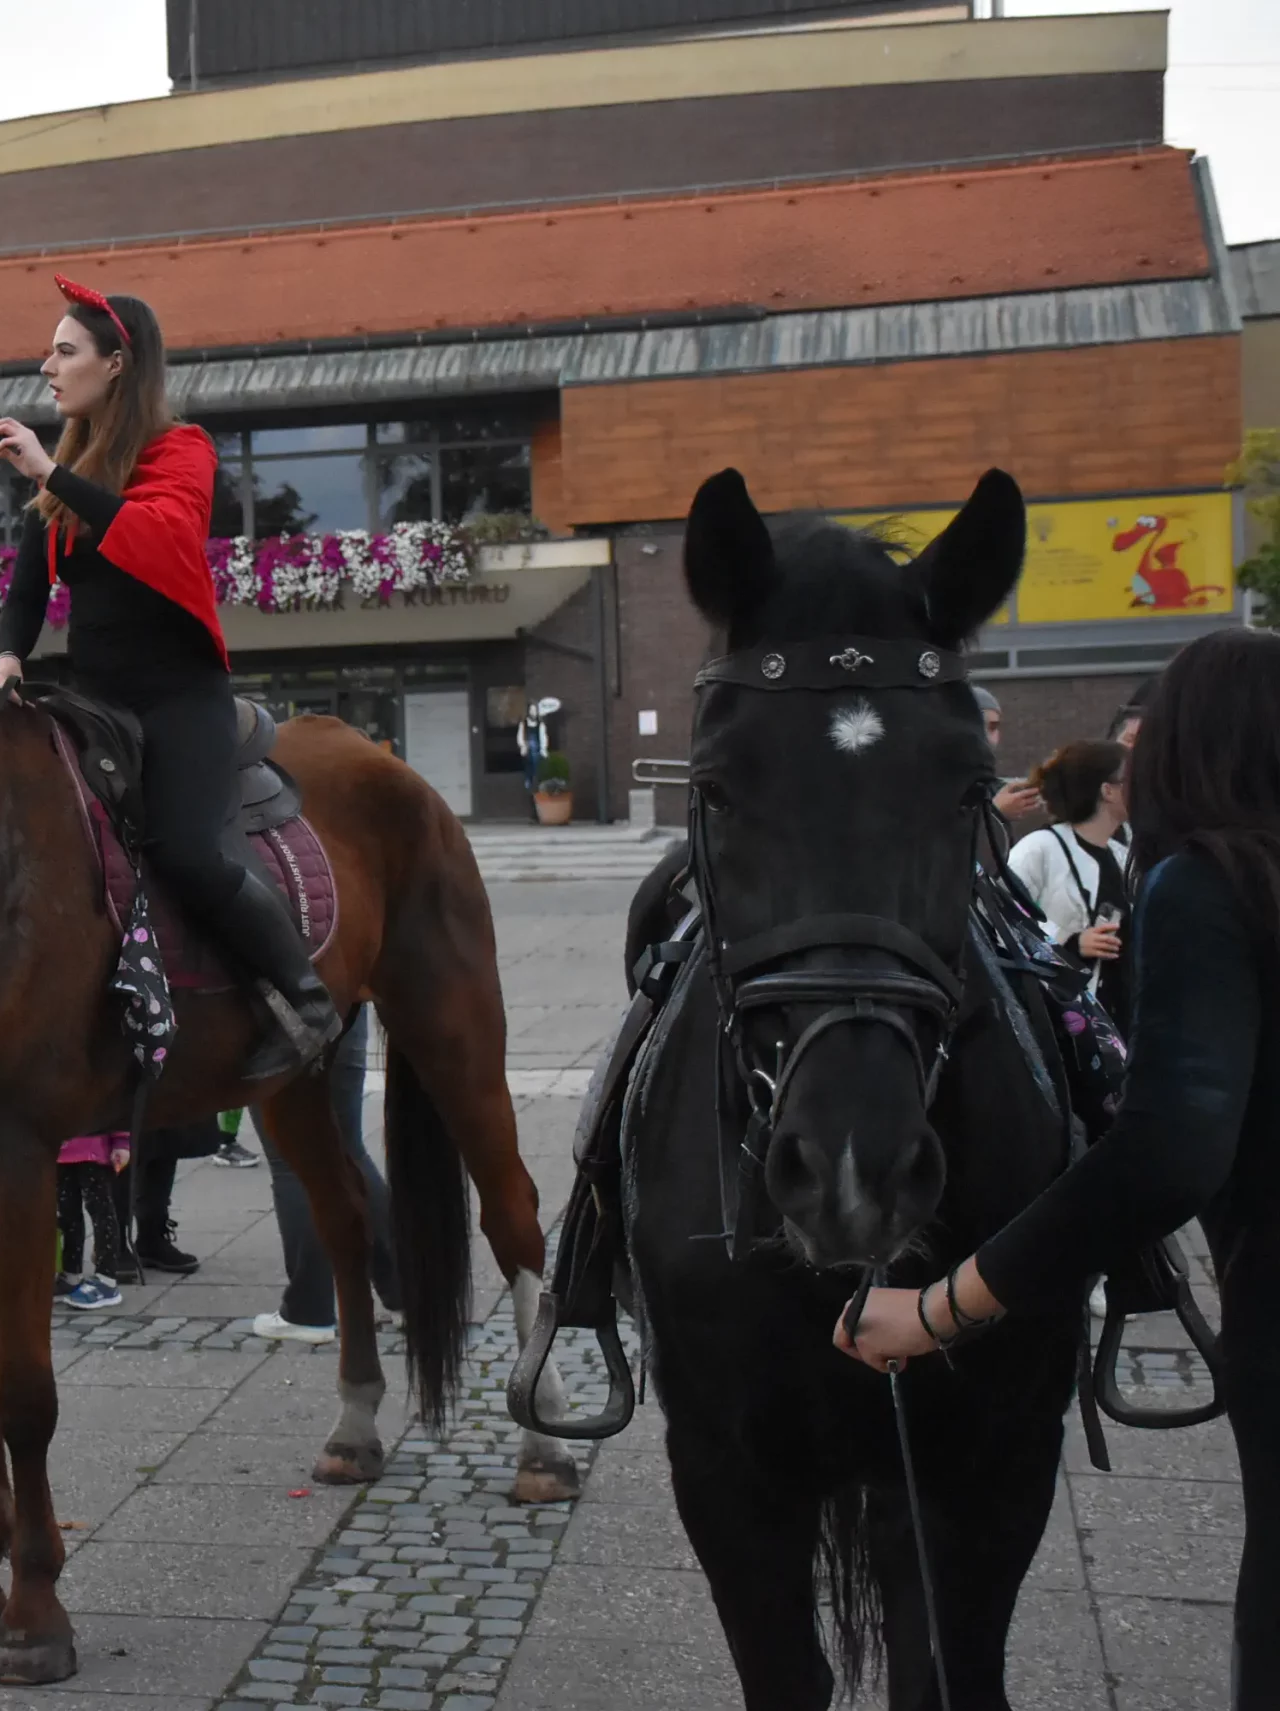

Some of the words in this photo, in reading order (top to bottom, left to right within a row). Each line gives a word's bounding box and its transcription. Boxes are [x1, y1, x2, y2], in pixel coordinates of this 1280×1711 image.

[280, 843, 295, 863] RIDE
[289, 862, 302, 886] JUST
[298, 890, 310, 914] RIDE
[301, 914, 310, 937] JUST
